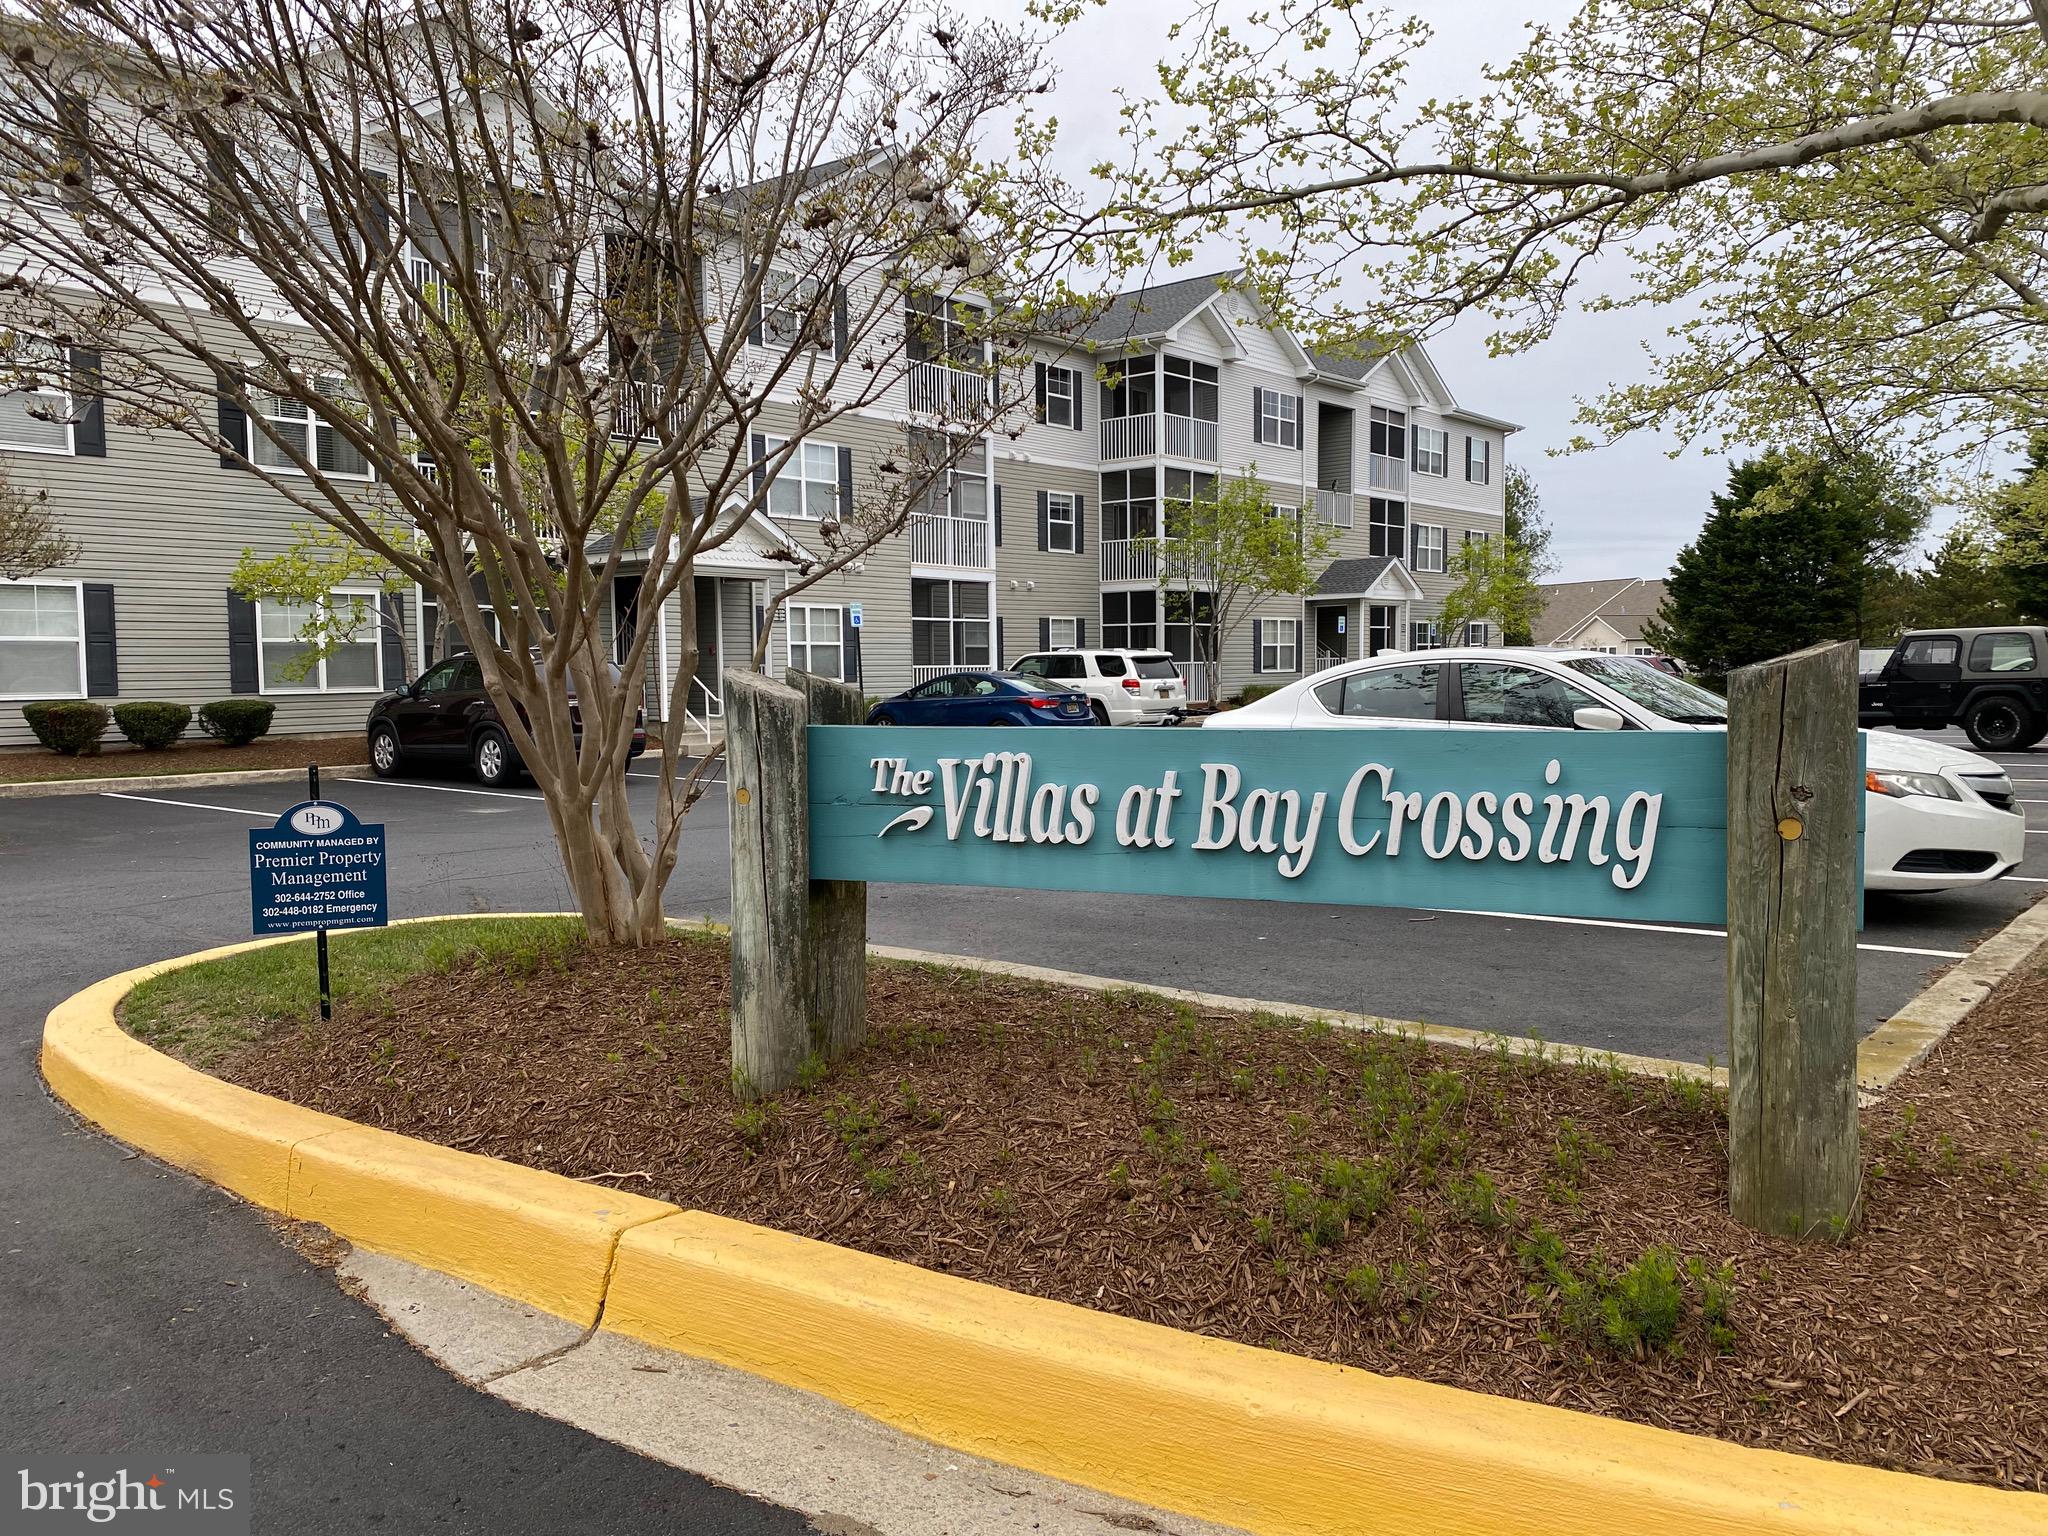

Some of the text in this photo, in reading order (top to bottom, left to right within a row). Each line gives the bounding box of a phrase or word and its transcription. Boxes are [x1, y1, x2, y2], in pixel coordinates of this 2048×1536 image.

[870, 751, 1664, 889] The Villas at Bay Crossing
[255, 836, 379, 850] COMMUNITY MANAGED BY
[254, 851, 382, 868] Premier Property
[271, 869, 368, 887] Management
[275, 889, 365, 903] 302-644-2752 Office
[262, 903, 378, 917] 302-448-0182 Emergency
[267, 916, 374, 929] www.prempropmgmt.com
